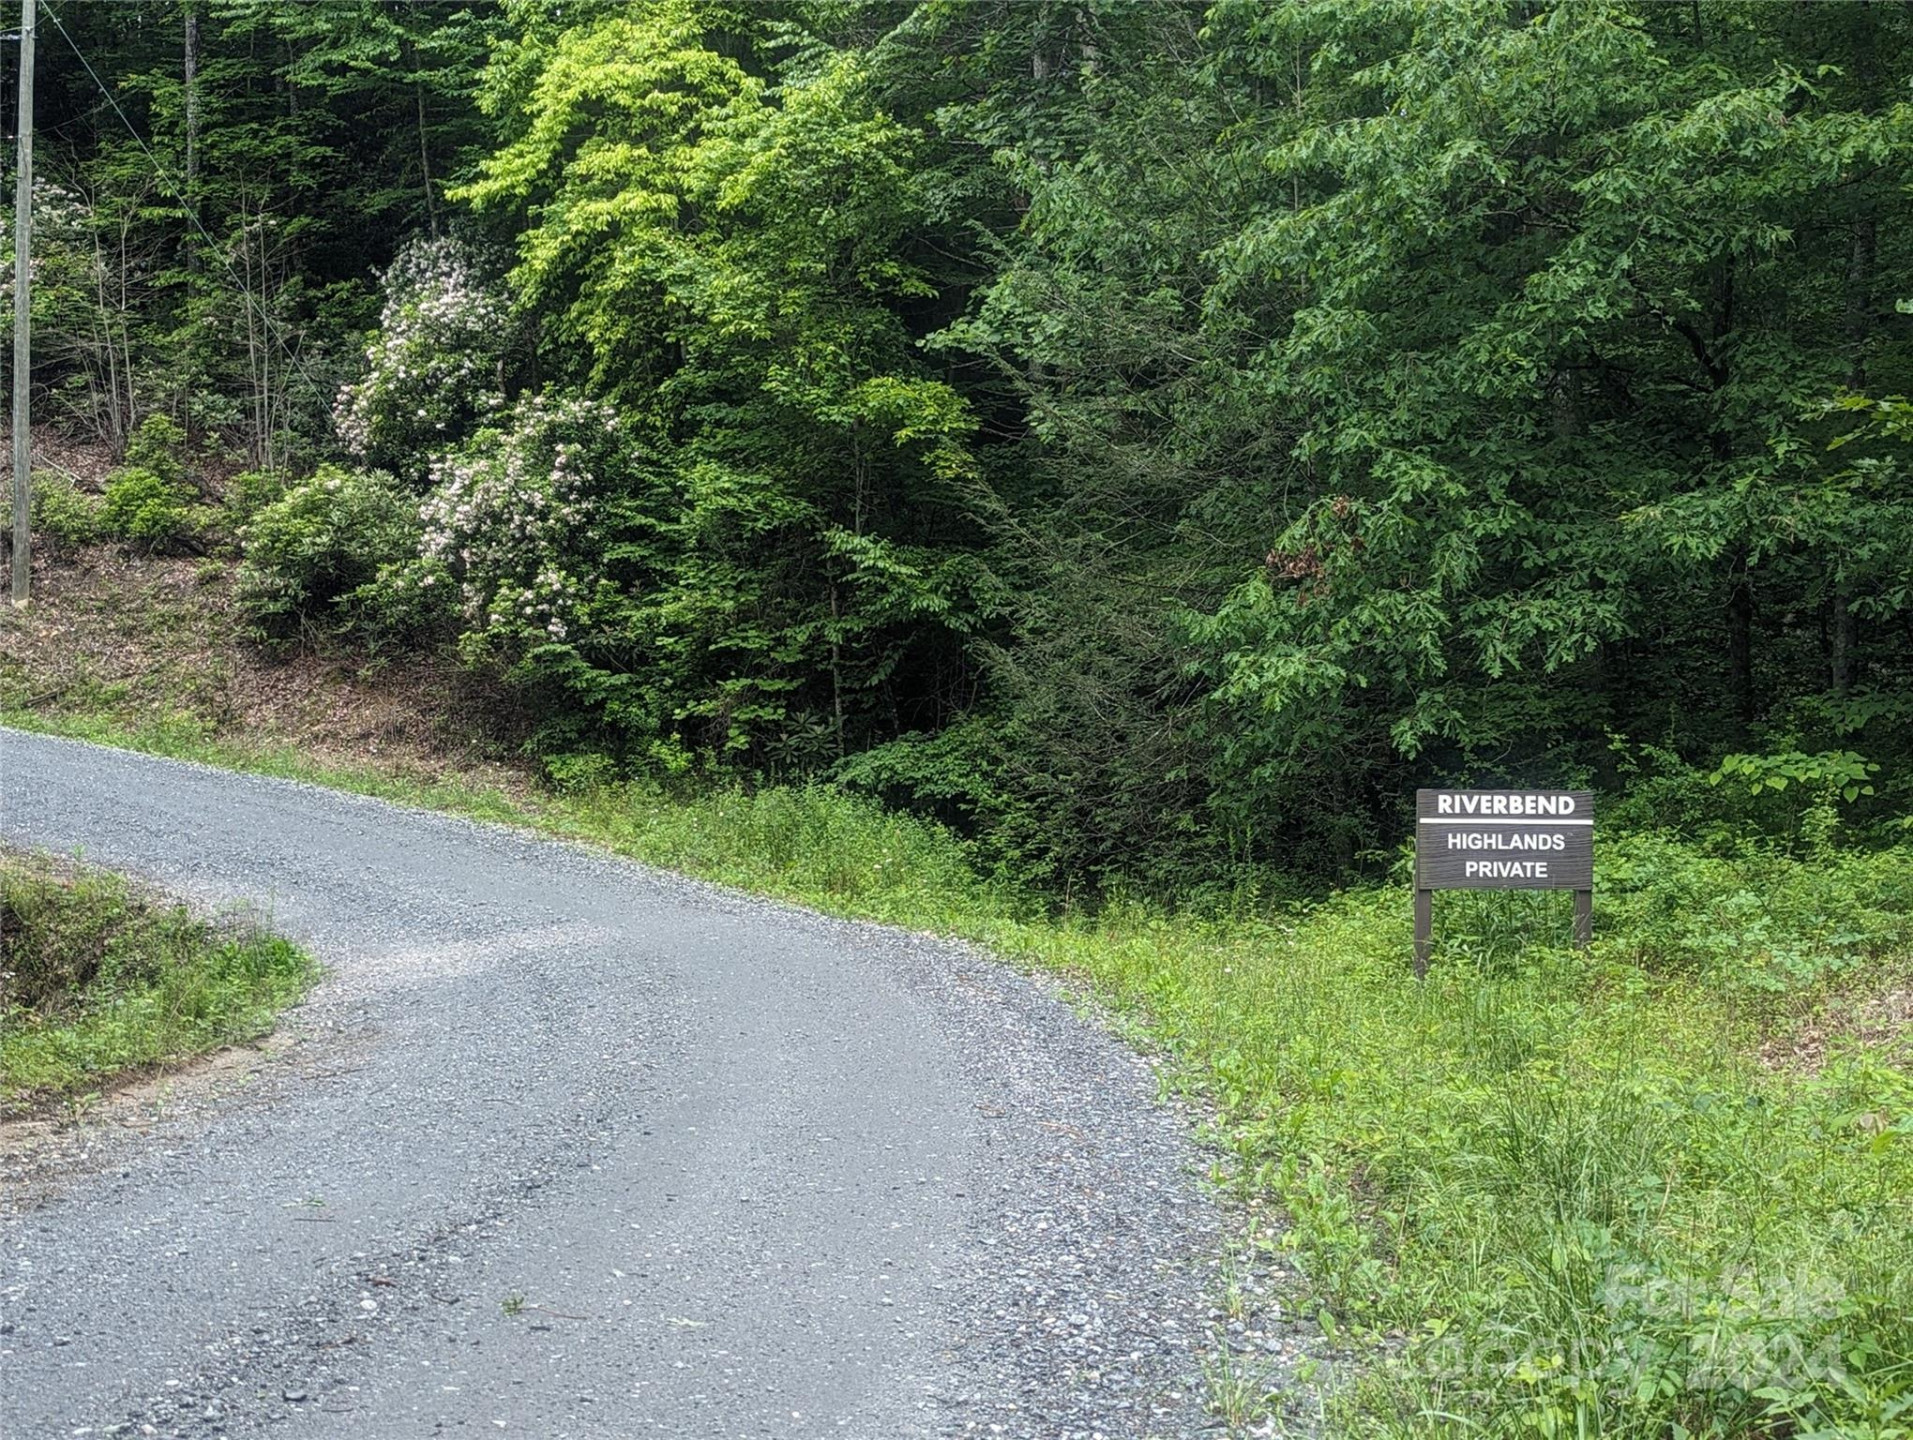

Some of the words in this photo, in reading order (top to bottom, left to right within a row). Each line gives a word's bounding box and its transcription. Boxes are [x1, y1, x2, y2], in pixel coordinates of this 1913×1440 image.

[1437, 794, 1576, 815] RIVERBEND
[1447, 833, 1566, 851] HIGHLANDS
[1465, 861, 1549, 878] PRIVATE
